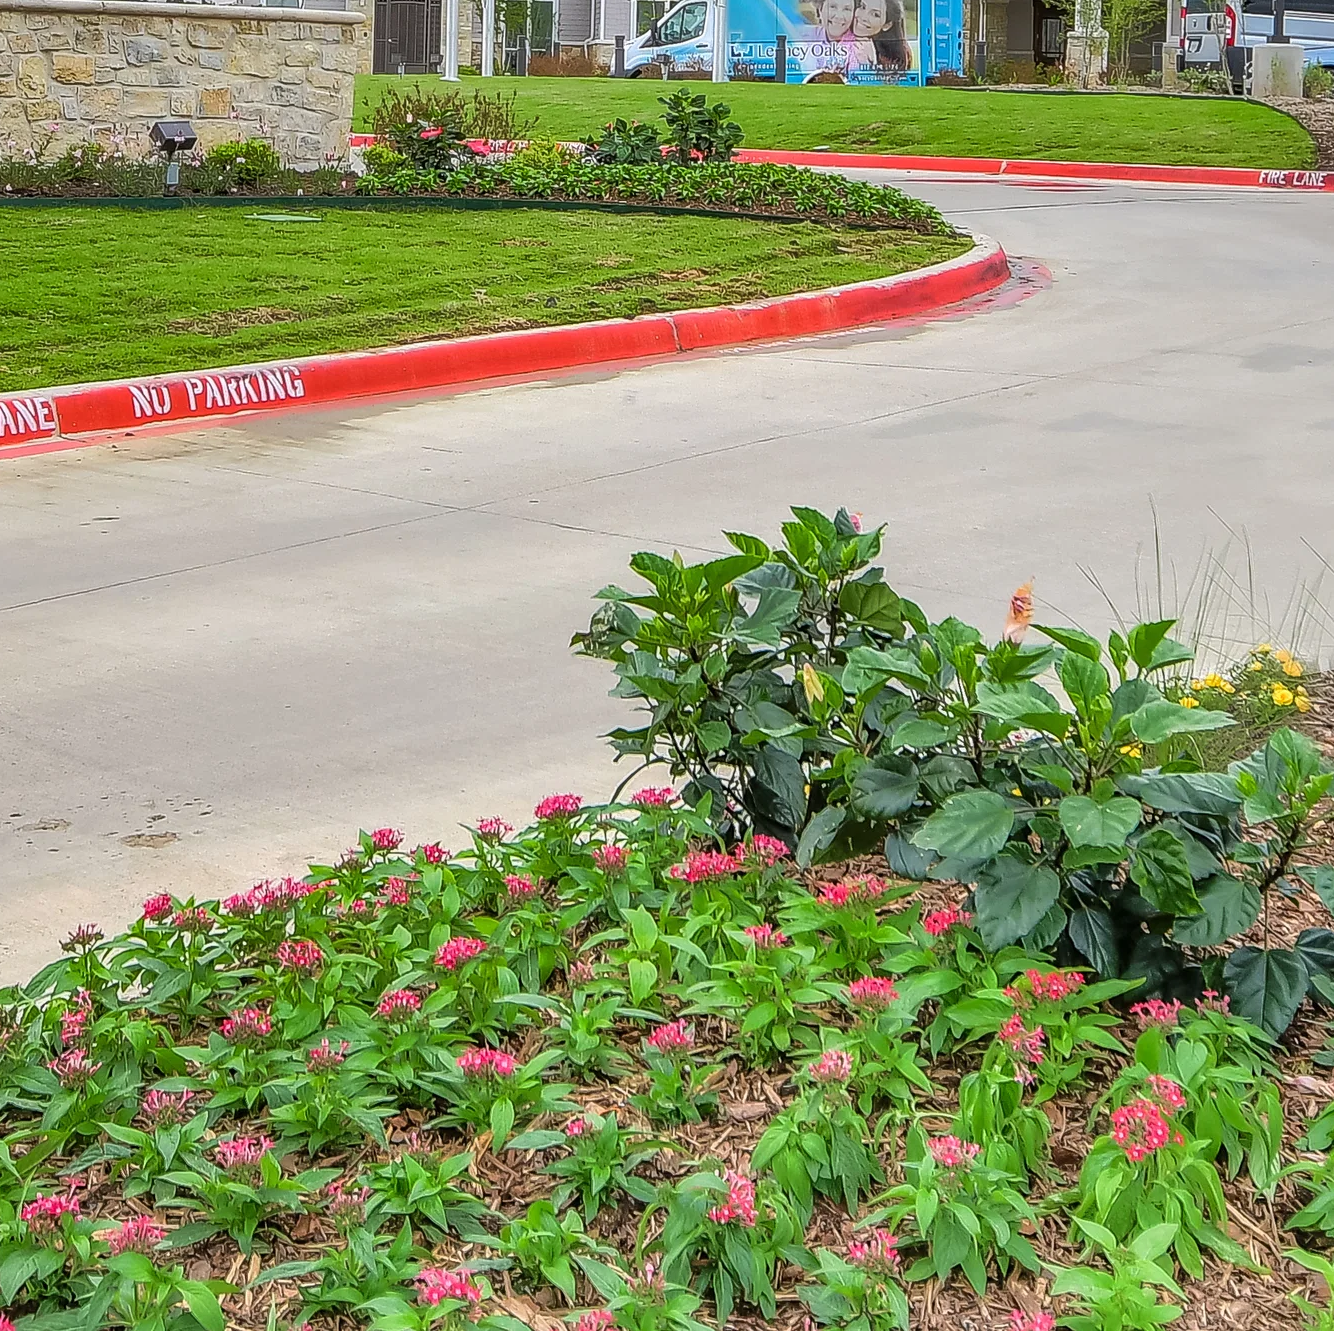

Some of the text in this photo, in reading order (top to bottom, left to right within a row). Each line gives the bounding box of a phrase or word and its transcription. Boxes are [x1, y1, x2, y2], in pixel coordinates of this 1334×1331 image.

[758, 42, 848, 61] Lecy Oaks
[1258, 170, 1288, 185] FIRE
[1292, 171, 1328, 187] LANE
[131, 383, 172, 419] NO
[183, 365, 306, 412] PARKING
